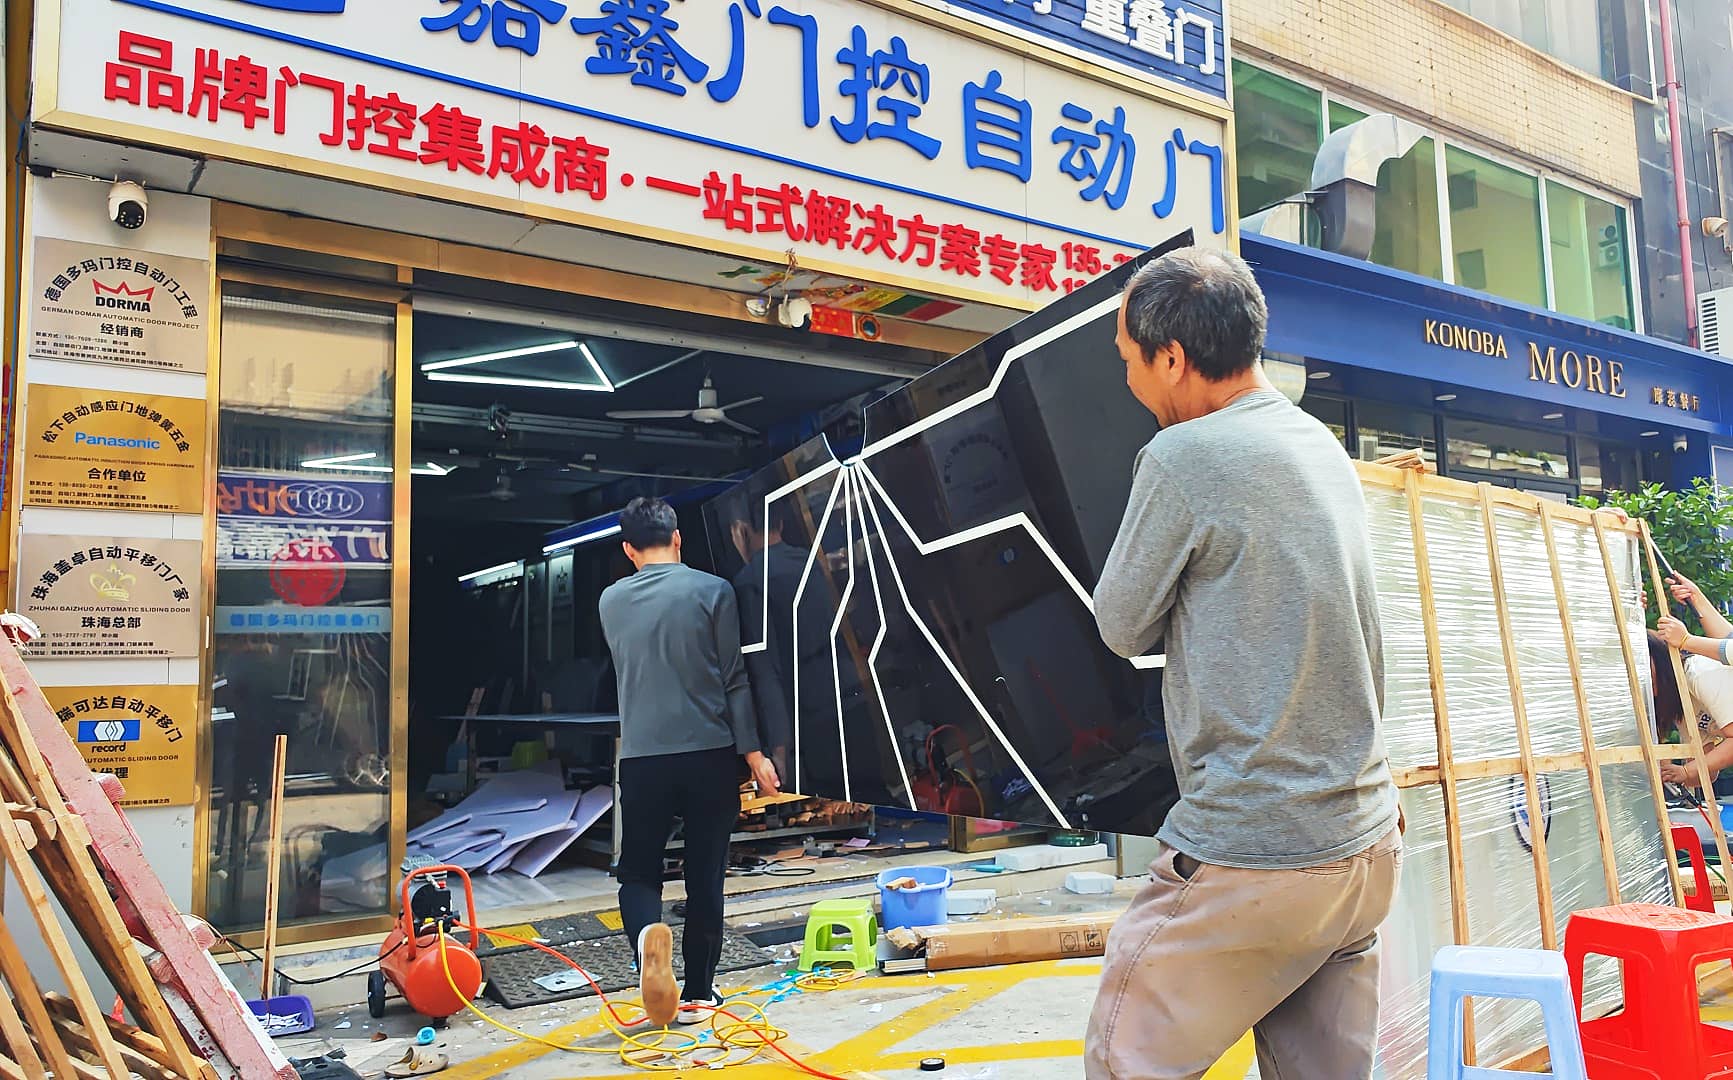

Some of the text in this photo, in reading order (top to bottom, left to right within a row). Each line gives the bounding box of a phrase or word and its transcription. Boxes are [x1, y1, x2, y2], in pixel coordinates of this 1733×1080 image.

[44, 257, 198, 320] 德国多玛门控自动门工程
[95, 297, 151, 313] DORMA
[41, 306, 74, 316] GERMAN
[103, 313, 145, 324] AUTOMATIC
[146, 318, 167, 327] DOOR
[168, 321, 200, 331] PROJECT
[100, 323, 145, 339] 经销商
[1424, 319, 1508, 360] KONOBA
[1528, 341, 1627, 398] MORE
[42, 399, 191, 453] 松下自动感应门地弹簧五金
[75, 431, 161, 450] Panasonic
[88, 467, 147, 482] 合作单位
[31, 545, 190, 602] 珠海盖卓自动平移门厂家
[81, 616, 142, 629] 珠海总部
[56, 695, 184, 743] 瑞可达自动平移门
[91, 742, 127, 753] record
[127, 755, 157, 763] SLIDING
[158, 754, 179, 762] DOOR
